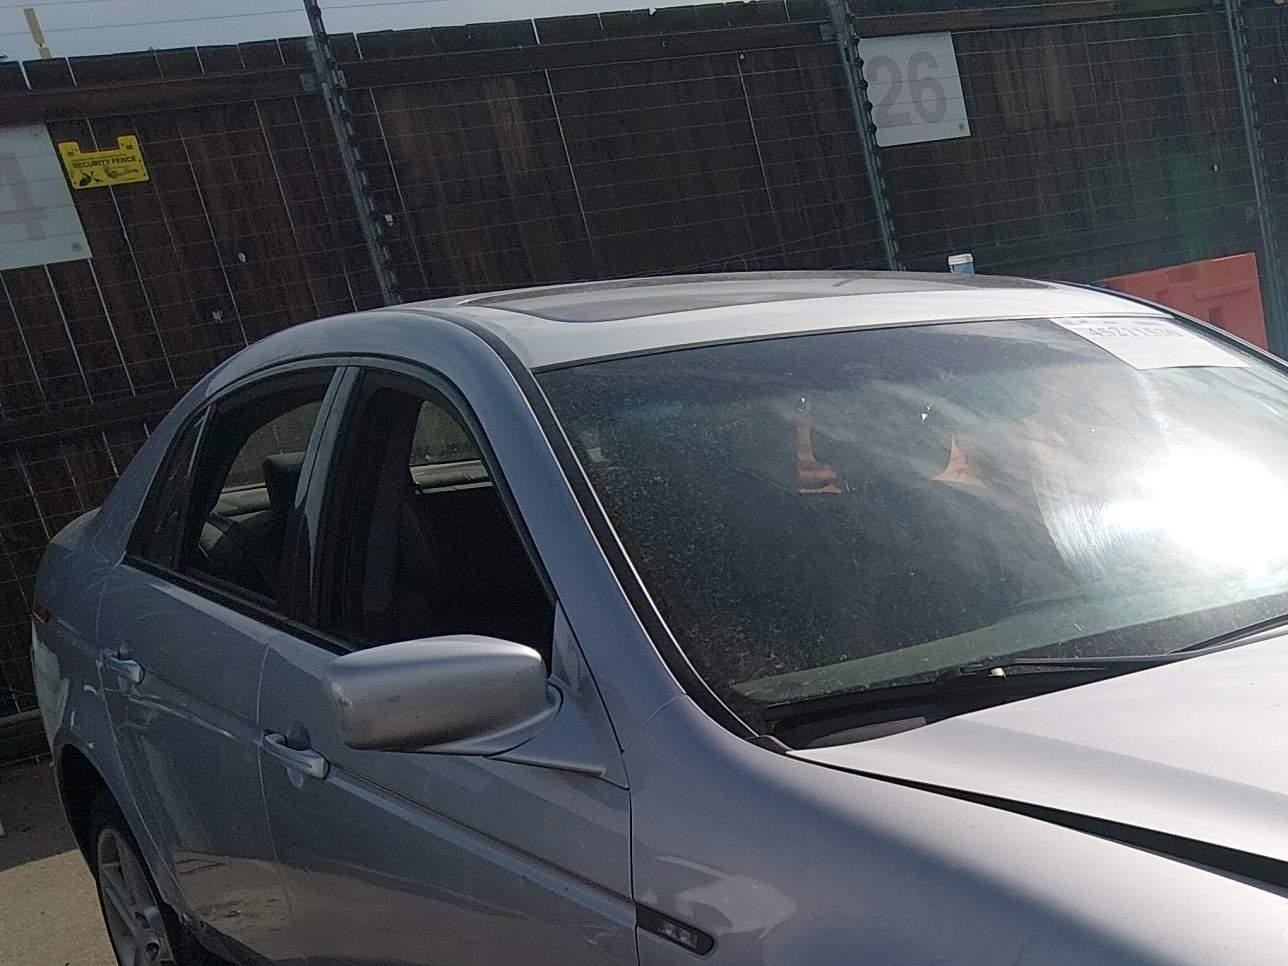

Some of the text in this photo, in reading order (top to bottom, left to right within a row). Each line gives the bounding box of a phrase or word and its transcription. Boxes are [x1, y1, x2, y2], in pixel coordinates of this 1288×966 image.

[865, 50, 946, 129] 26
[72, 159, 110, 169] SECURITY
[111, 155, 137, 164] FENCE
